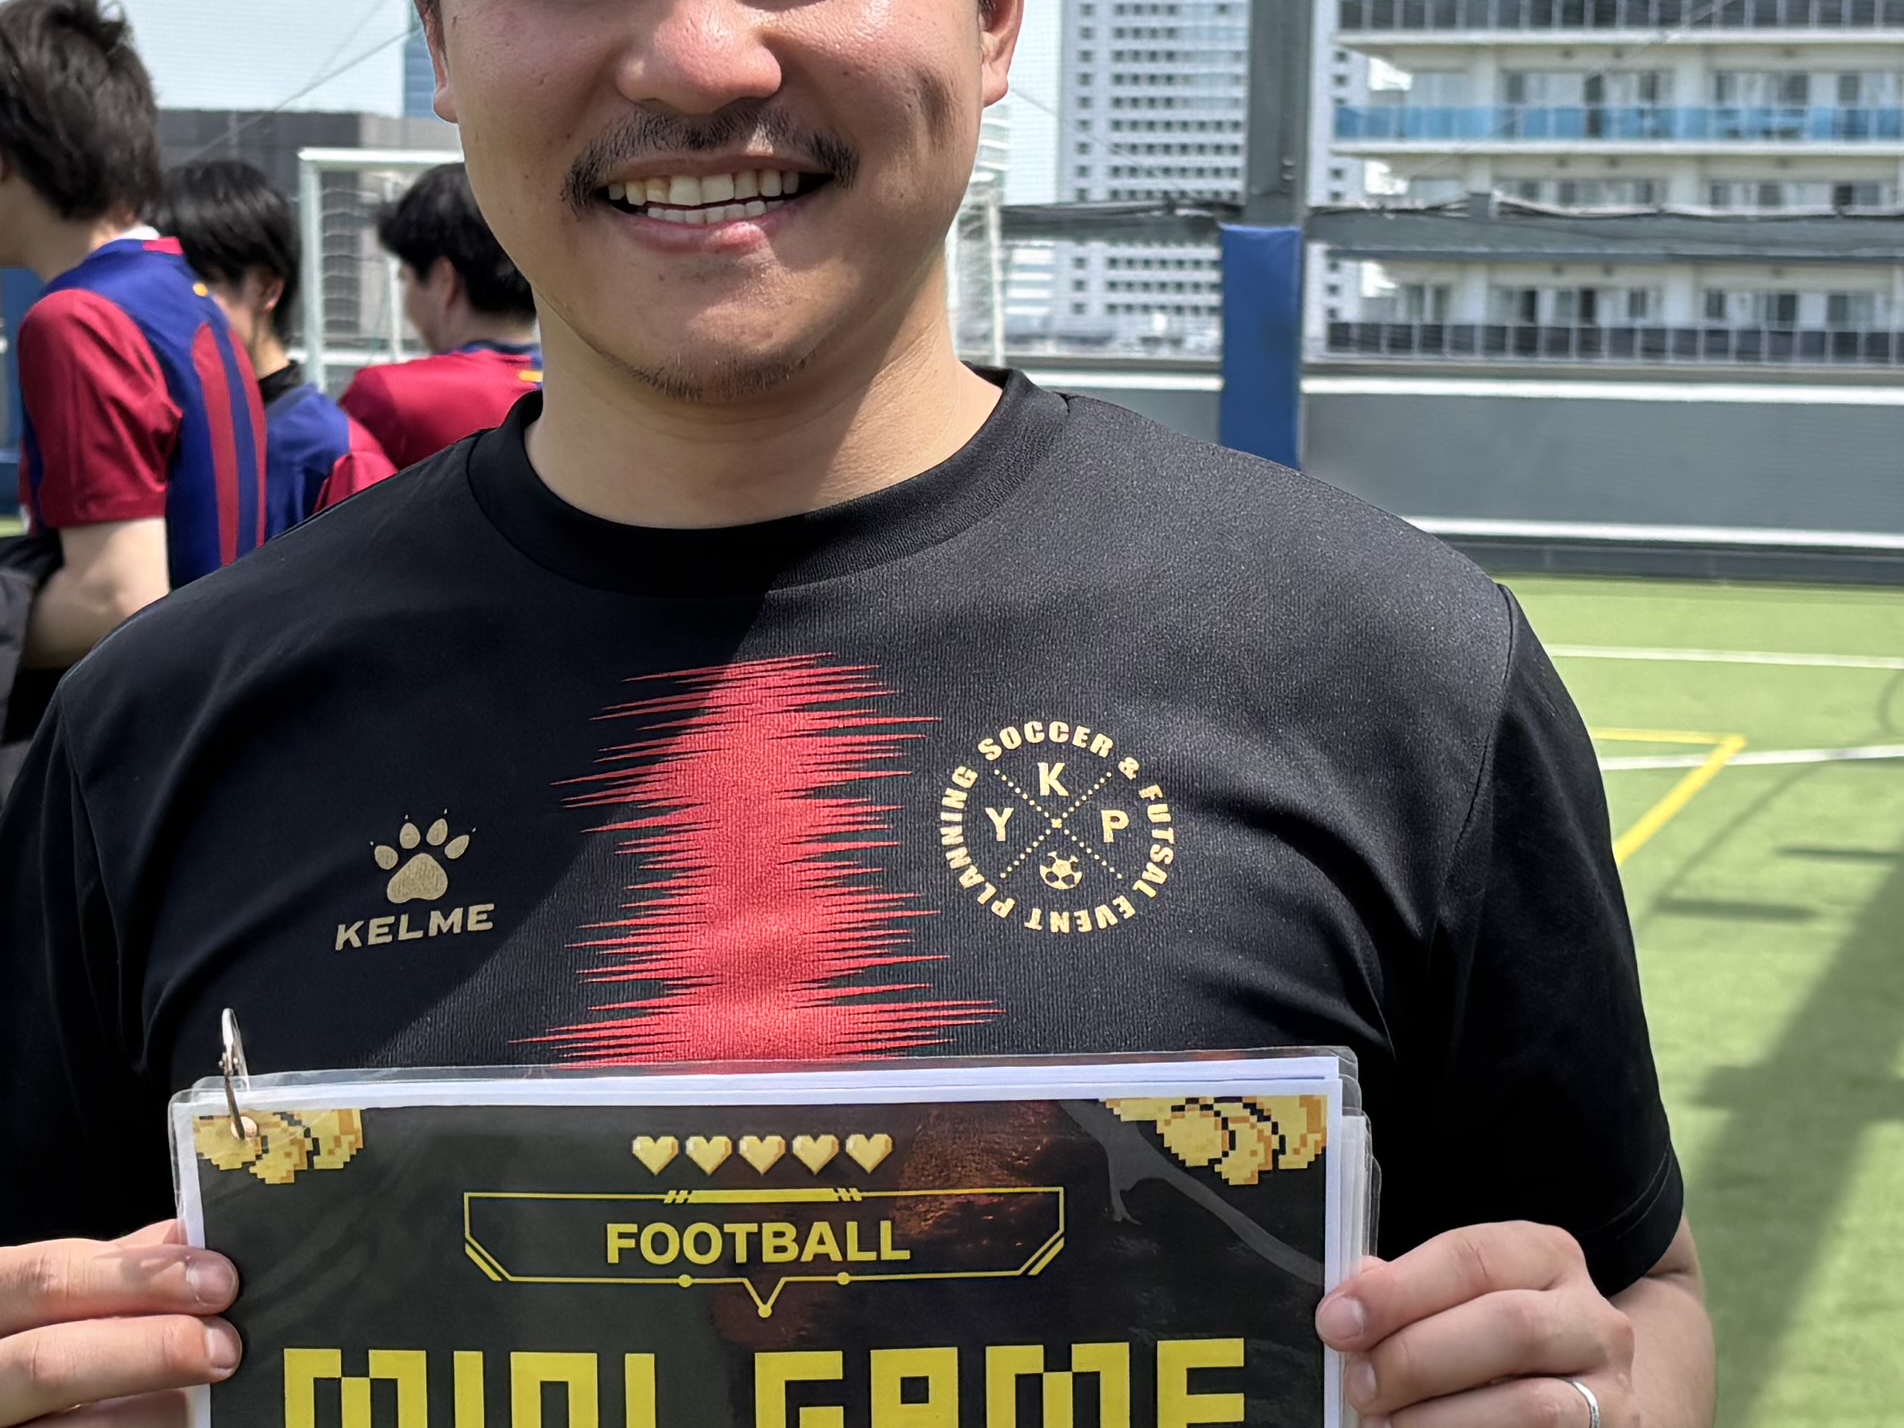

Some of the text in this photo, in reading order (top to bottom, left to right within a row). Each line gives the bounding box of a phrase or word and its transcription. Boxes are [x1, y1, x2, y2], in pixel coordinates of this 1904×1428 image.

[1037, 761, 1069, 796] K
[939, 721, 1175, 933] SOCCER & FUTSAL EVENT PLANNING
[985, 807, 1014, 842] Y
[1100, 809, 1130, 843] P
[334, 903, 495, 951] KELME
[605, 1220, 911, 1265] FOOTBALL
